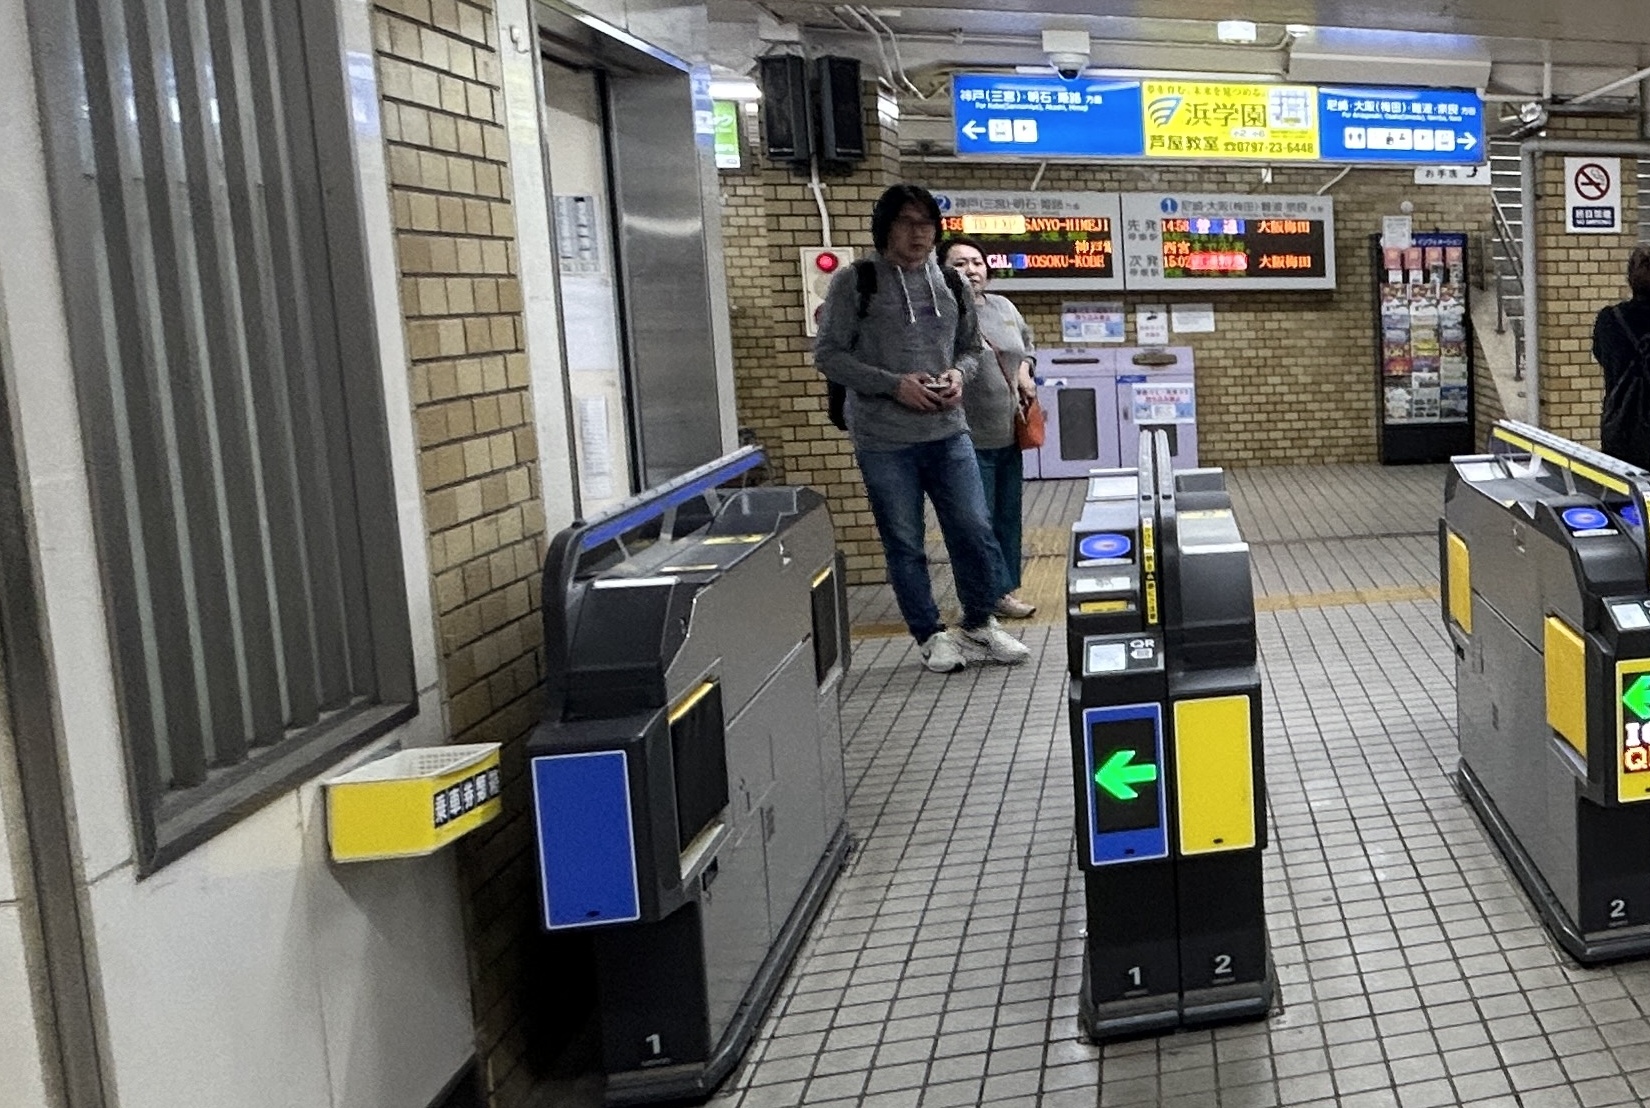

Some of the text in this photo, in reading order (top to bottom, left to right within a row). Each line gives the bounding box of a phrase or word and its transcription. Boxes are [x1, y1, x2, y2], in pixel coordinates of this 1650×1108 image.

[1185, 102, 1267, 128] 浜学園
[1149, 135, 1219, 151] 芦屋教室
[1129, 639, 1155, 648] QR
[1609, 899, 1626, 919] 2
[1214, 955, 1231, 975] 2
[1127, 967, 1141, 986] 1
[645, 1034, 661, 1054] 1
